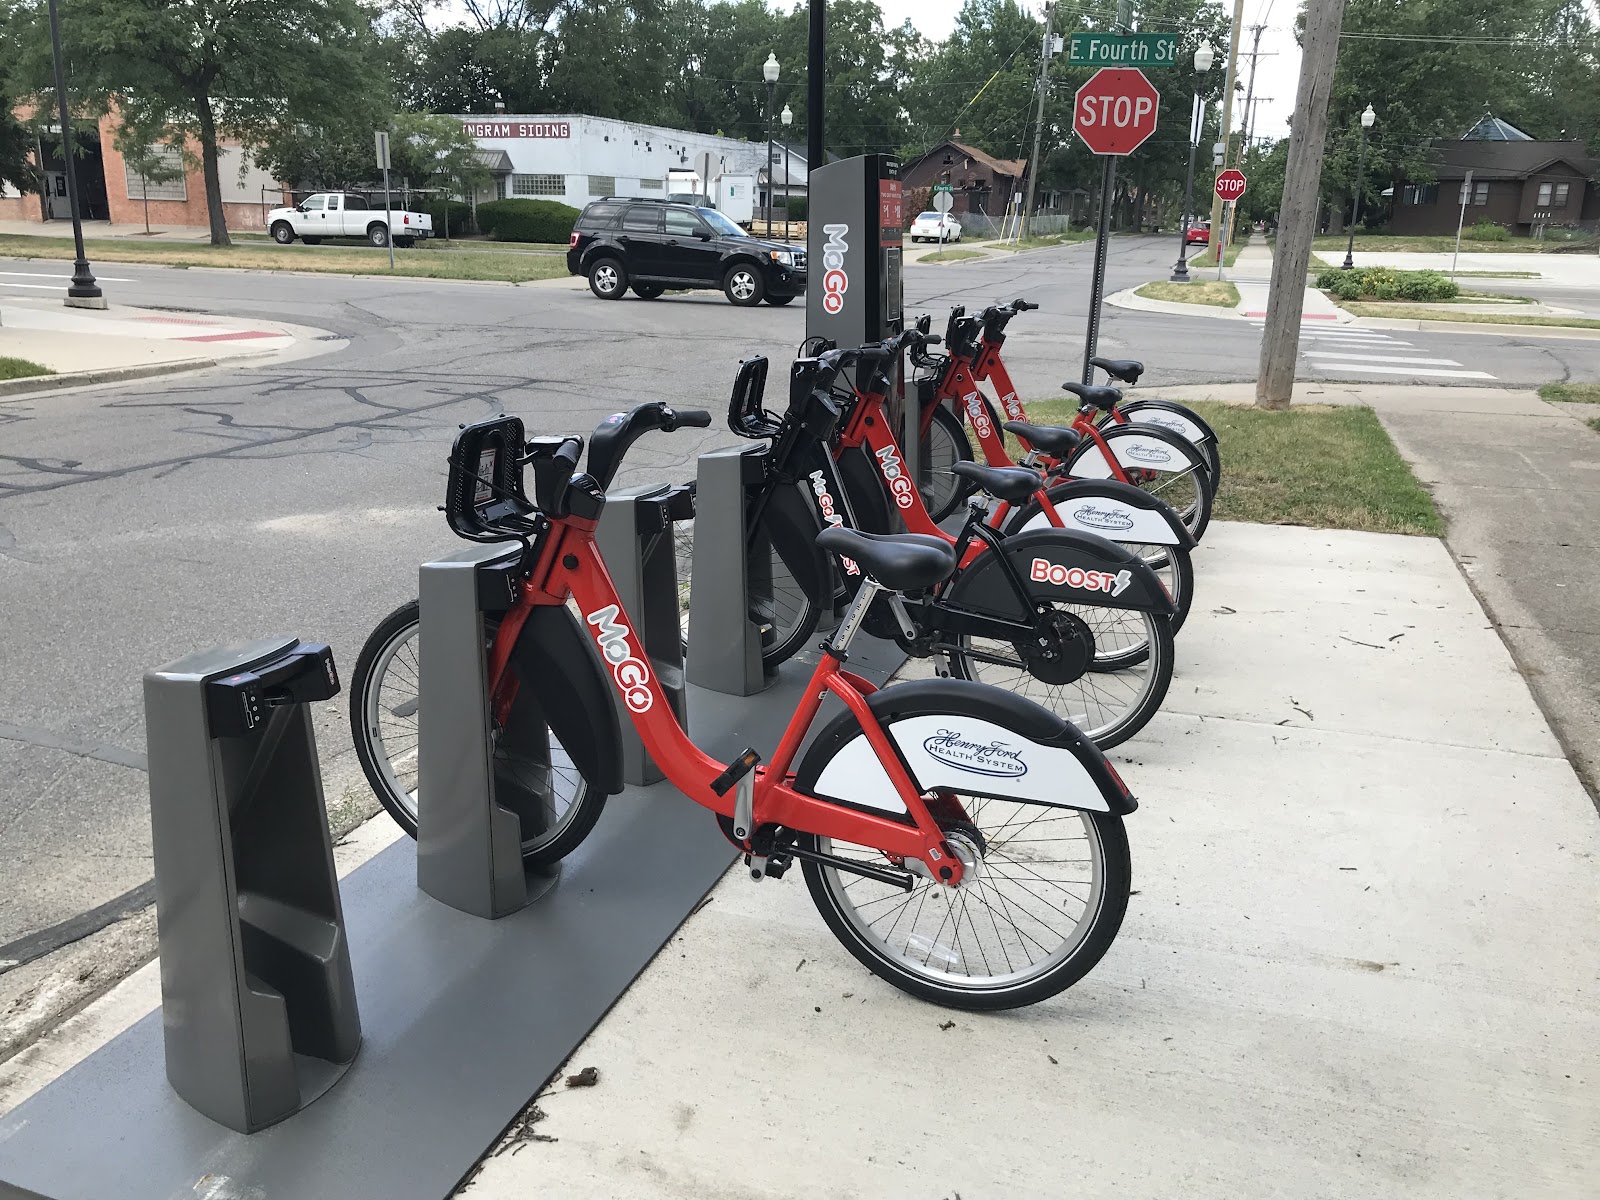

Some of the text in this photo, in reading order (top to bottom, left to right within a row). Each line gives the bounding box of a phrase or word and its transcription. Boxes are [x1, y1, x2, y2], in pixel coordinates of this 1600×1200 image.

[1070, 39, 1176, 60] E. Fourth St
[1080, 95, 1153, 128] STOP
[519, 124, 568, 137] SIDING
[1216, 179, 1244, 192] STOP
[1080, 504, 1131, 520] Henry Ford
[934, 728, 1023, 760] Henry Ford
[929, 743, 1024, 772] HEALTH SYSTEM
